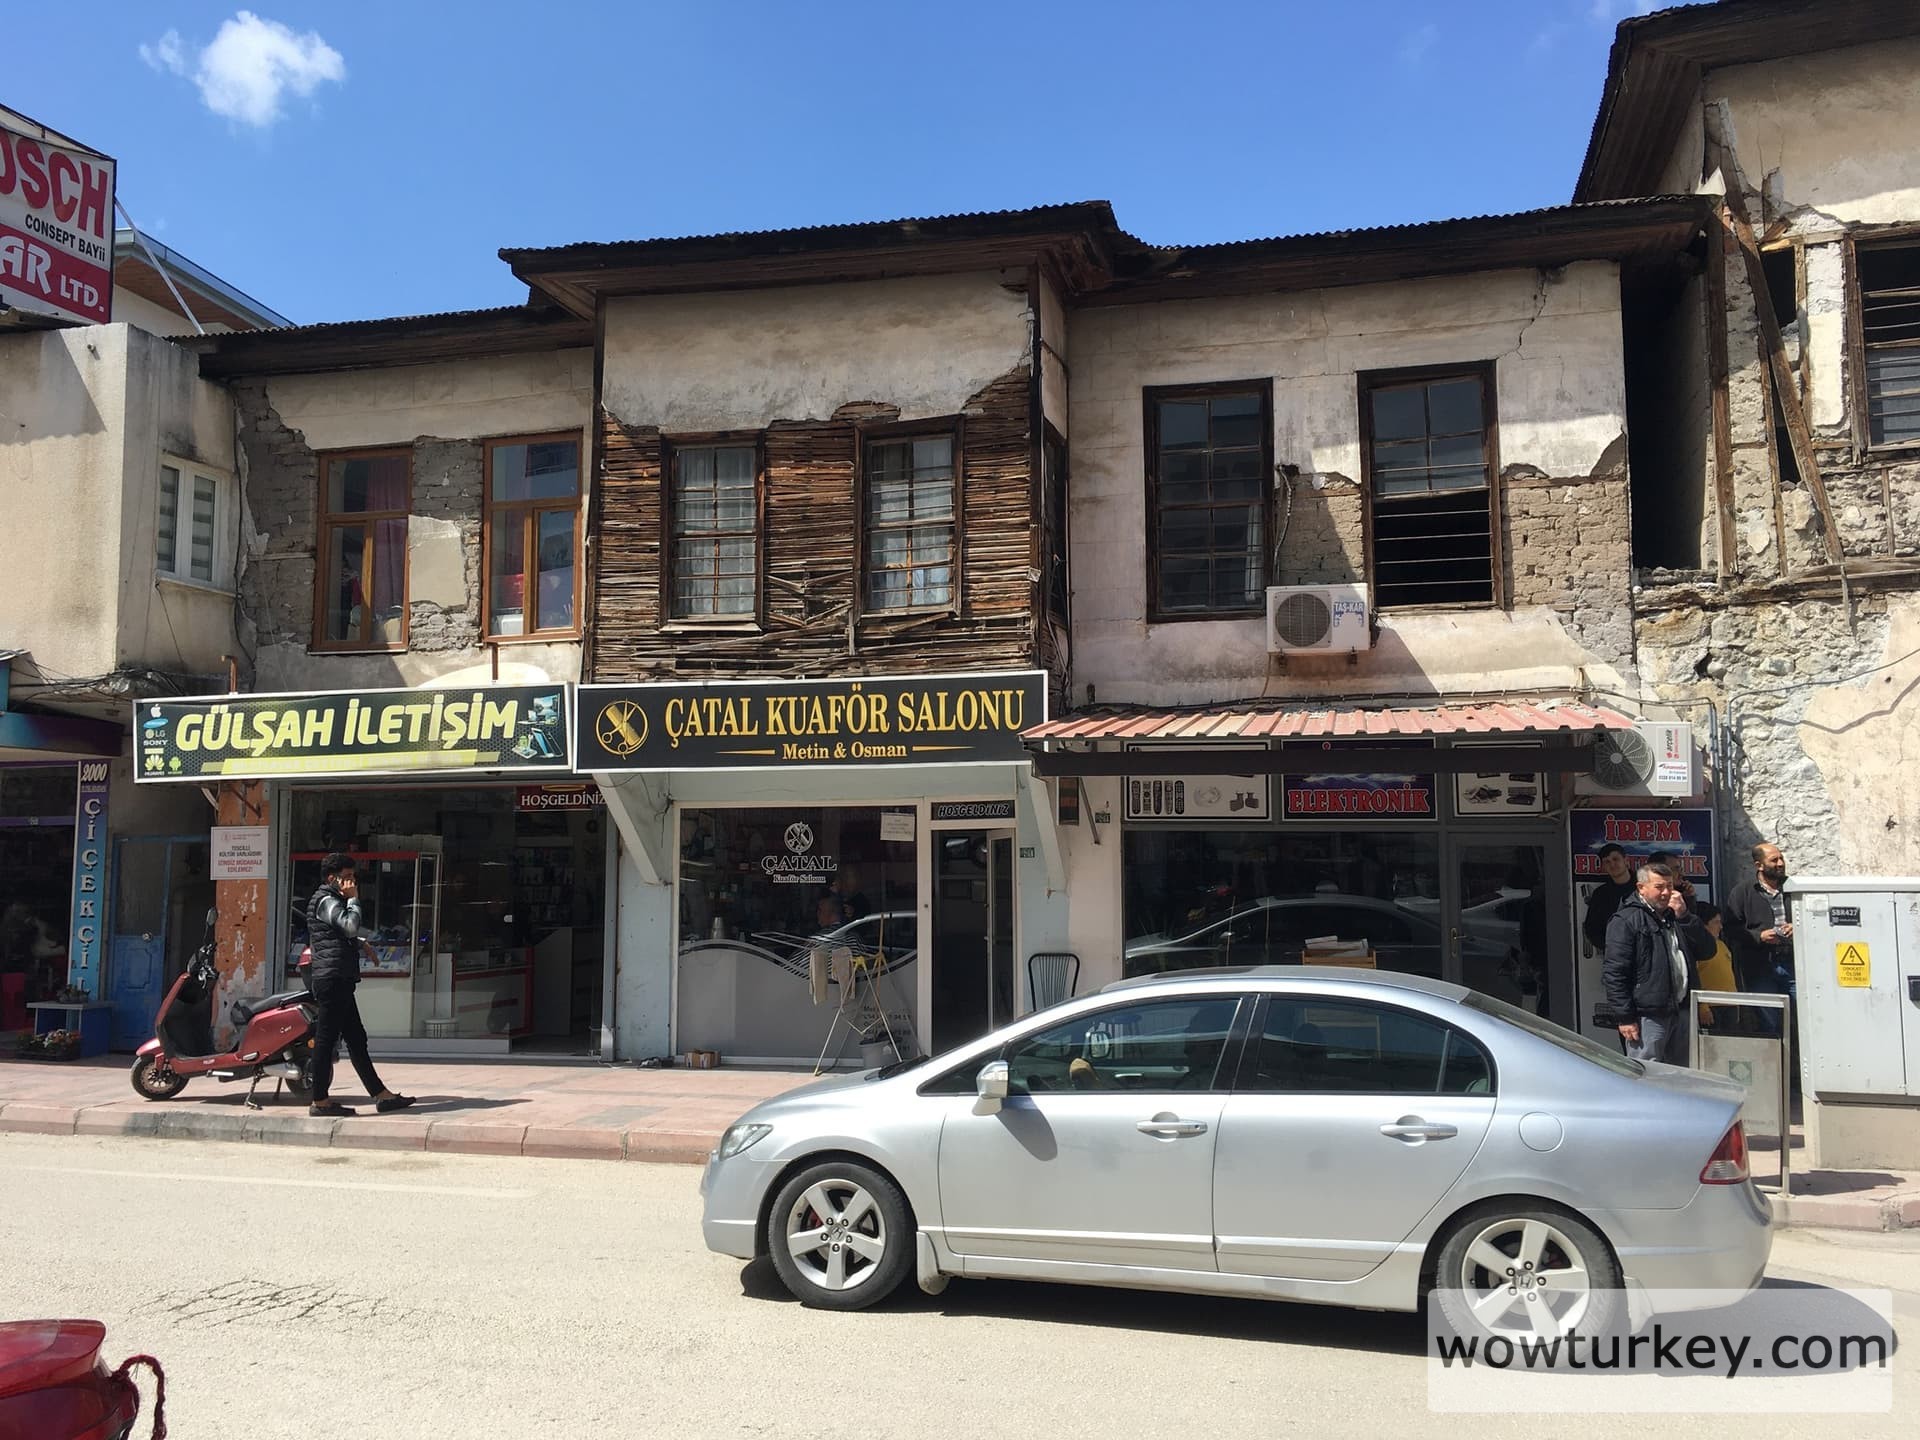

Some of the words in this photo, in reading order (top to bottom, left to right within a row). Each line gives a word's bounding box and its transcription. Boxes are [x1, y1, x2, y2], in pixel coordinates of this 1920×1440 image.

[25, 213, 76, 249] CONSEPT
[60, 274, 105, 313] LTD.
[175, 706, 335, 758] GÜLŞAH
[342, 692, 520, 750] İLETİŞİM
[664, 696, 758, 748] ÇATAL
[765, 683, 890, 735] KUAFÖR
[897, 689, 1024, 732] SALONU
[782, 742, 829, 761] Metin
[833, 741, 847, 758] &
[851, 741, 907, 758] Osman
[81, 763, 108, 782] 2000
[1288, 782, 1430, 813] ELEKTRONİK
[1604, 813, 1682, 842] İREM
[761, 855, 838, 875] ÇATAL
